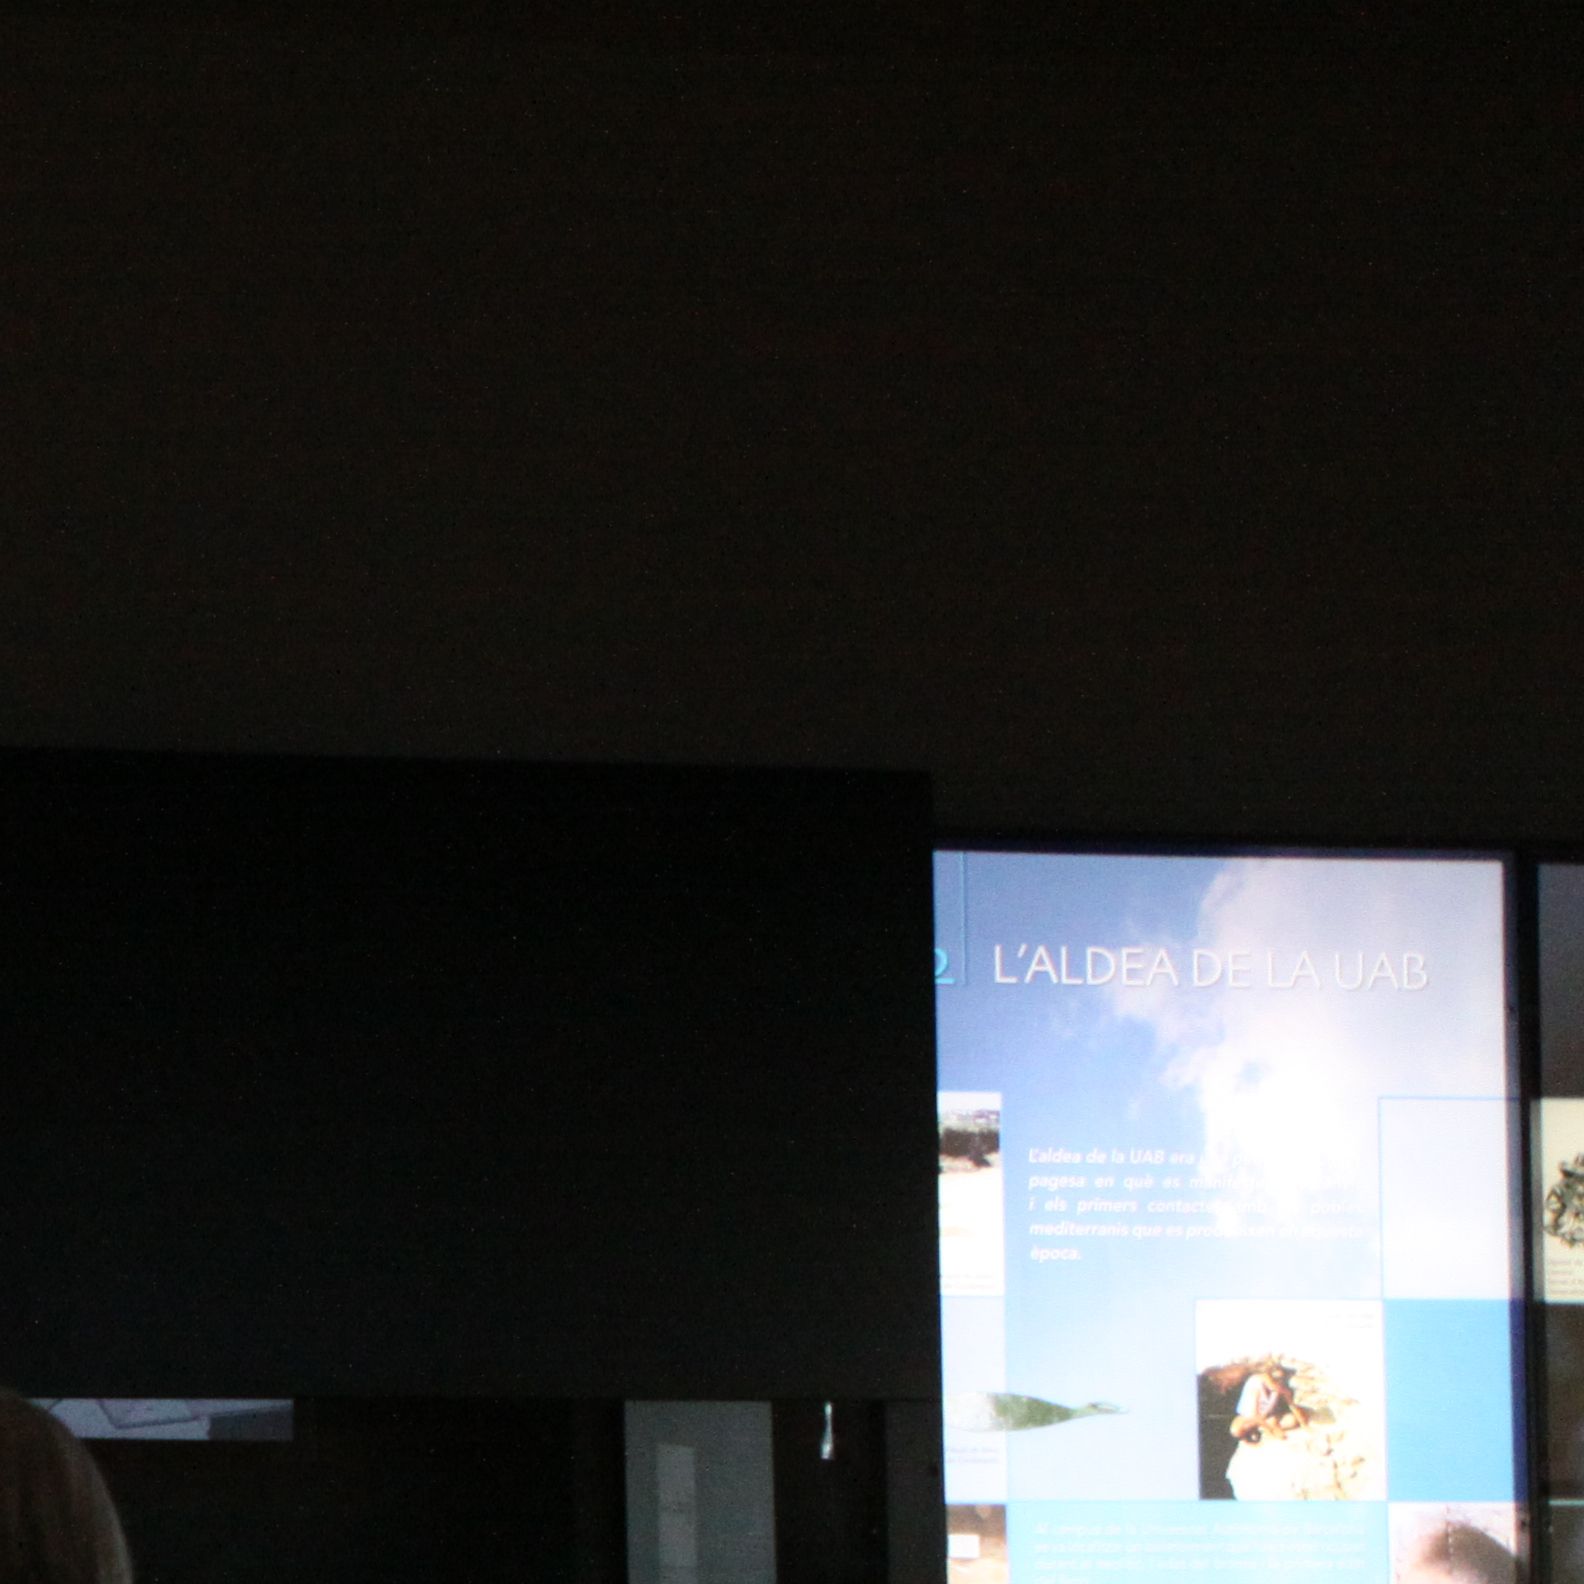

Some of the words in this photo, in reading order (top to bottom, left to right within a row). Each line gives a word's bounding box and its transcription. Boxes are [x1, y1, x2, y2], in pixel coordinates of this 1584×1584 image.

[994, 944, 1181, 988] L'ALDEA
[1193, 948, 1254, 988] DE
[1267, 950, 1324, 989] LA
[1334, 951, 1430, 992] UAB
[1086, 1147, 1108, 1164] de
[1111, 1147, 1126, 1164] la
[1130, 1149, 1166, 1164] UAB
[1169, 1152, 1196, 1165] era
[1028, 1175, 1087, 1191] pagesa
[1094, 1176, 1116, 1189] en
[1162, 1177, 1181, 1189] es
[1044, 1196, 1068, 1212] els
[1077, 1197, 1139, 1215] primers
[1029, 1221, 1130, 1237] mediterranis
[1132, 1224, 1163, 1240] que
[1165, 1225, 1184, 1238] es
